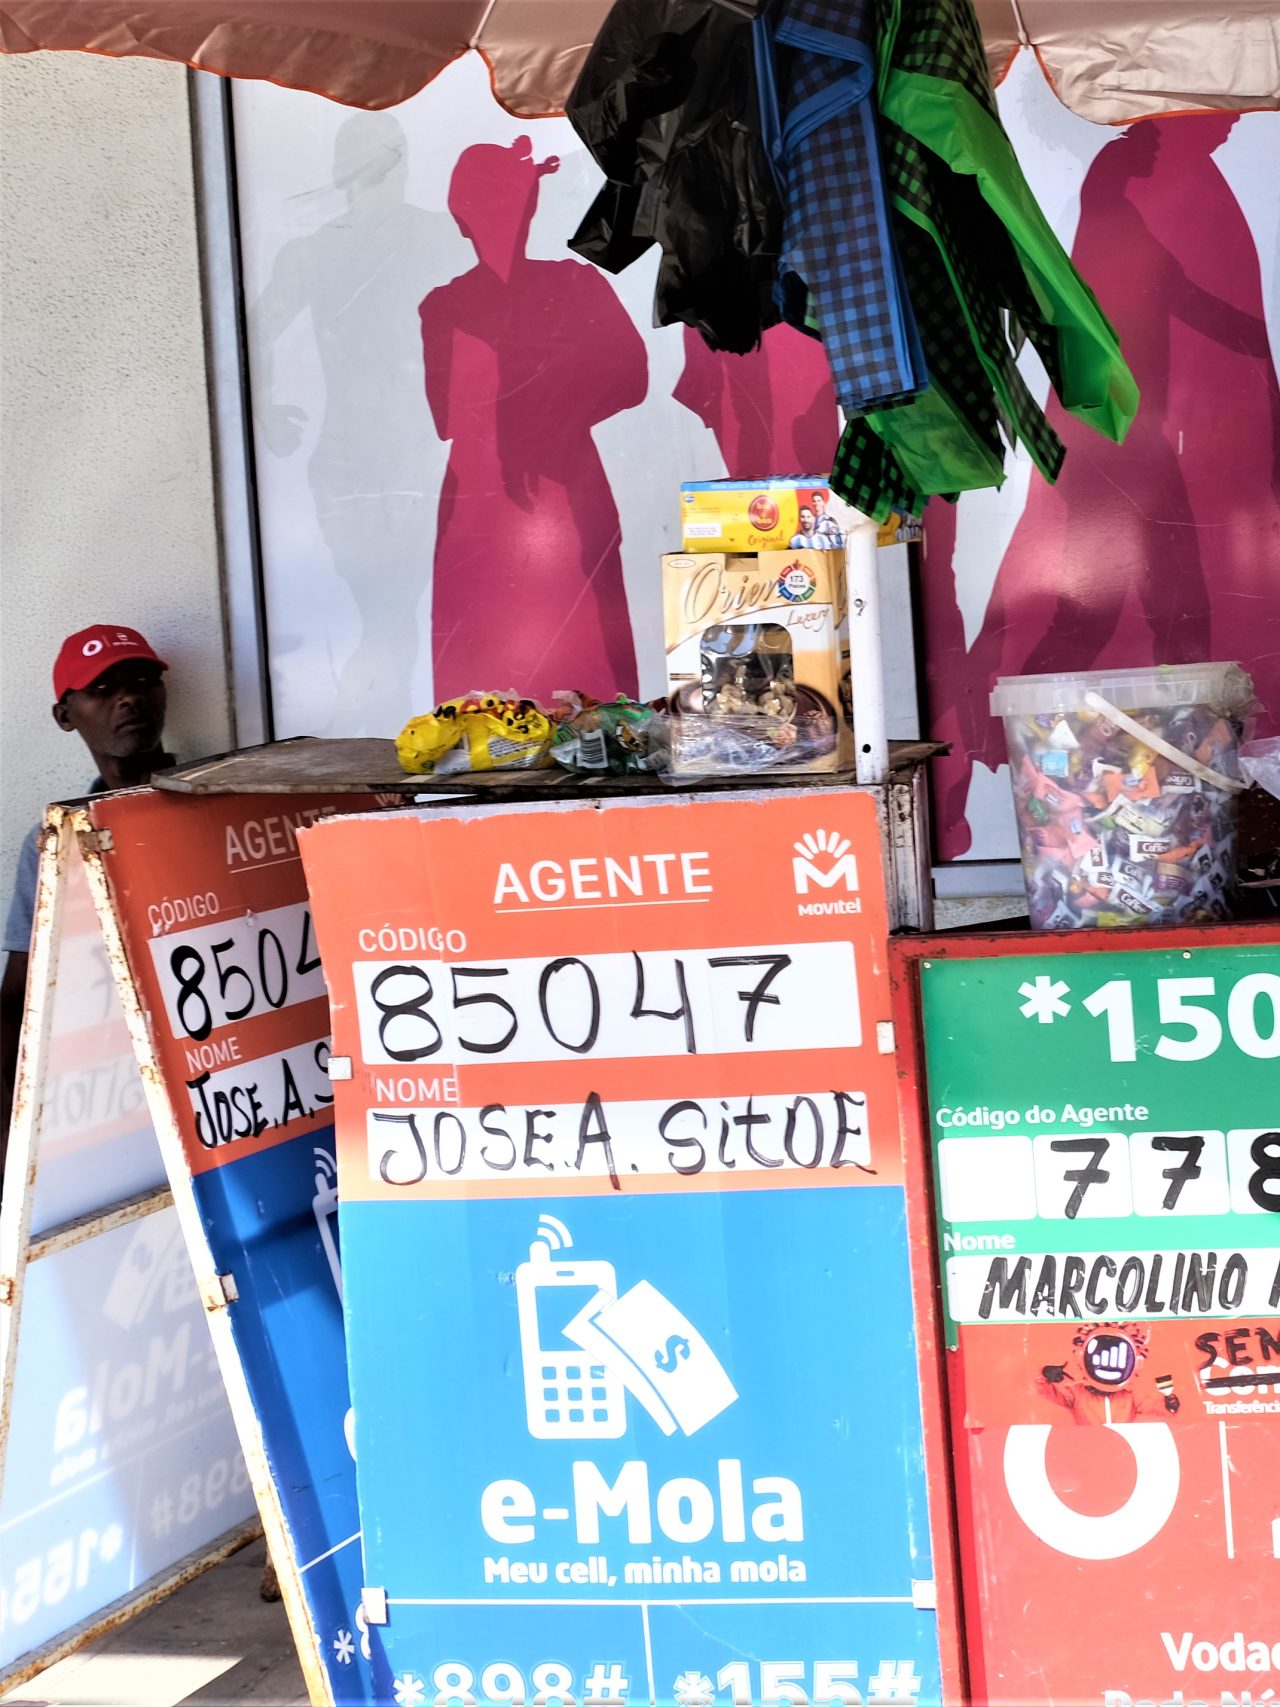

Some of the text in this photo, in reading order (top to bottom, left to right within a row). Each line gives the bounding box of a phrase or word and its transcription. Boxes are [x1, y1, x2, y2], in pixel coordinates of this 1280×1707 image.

[225, 806, 336, 865] AGEN
[493, 850, 713, 905] AGENTE
[148, 891, 220, 930] CÓDIGO
[357, 921, 468, 954] CÓDIGO
[370, 950, 793, 1062] 85047
[184, 1036, 243, 1074] NOME
[374, 1076, 458, 1104] NOME
[936, 1102, 1150, 1131] Código do Agente
[943, 1231, 1016, 1252] Nome
[978, 1250, 1249, 1320] MARCOLINO
[480, 1459, 804, 1544] e-Mola
[483, 1556, 807, 1588] Meu cell, minha mola
